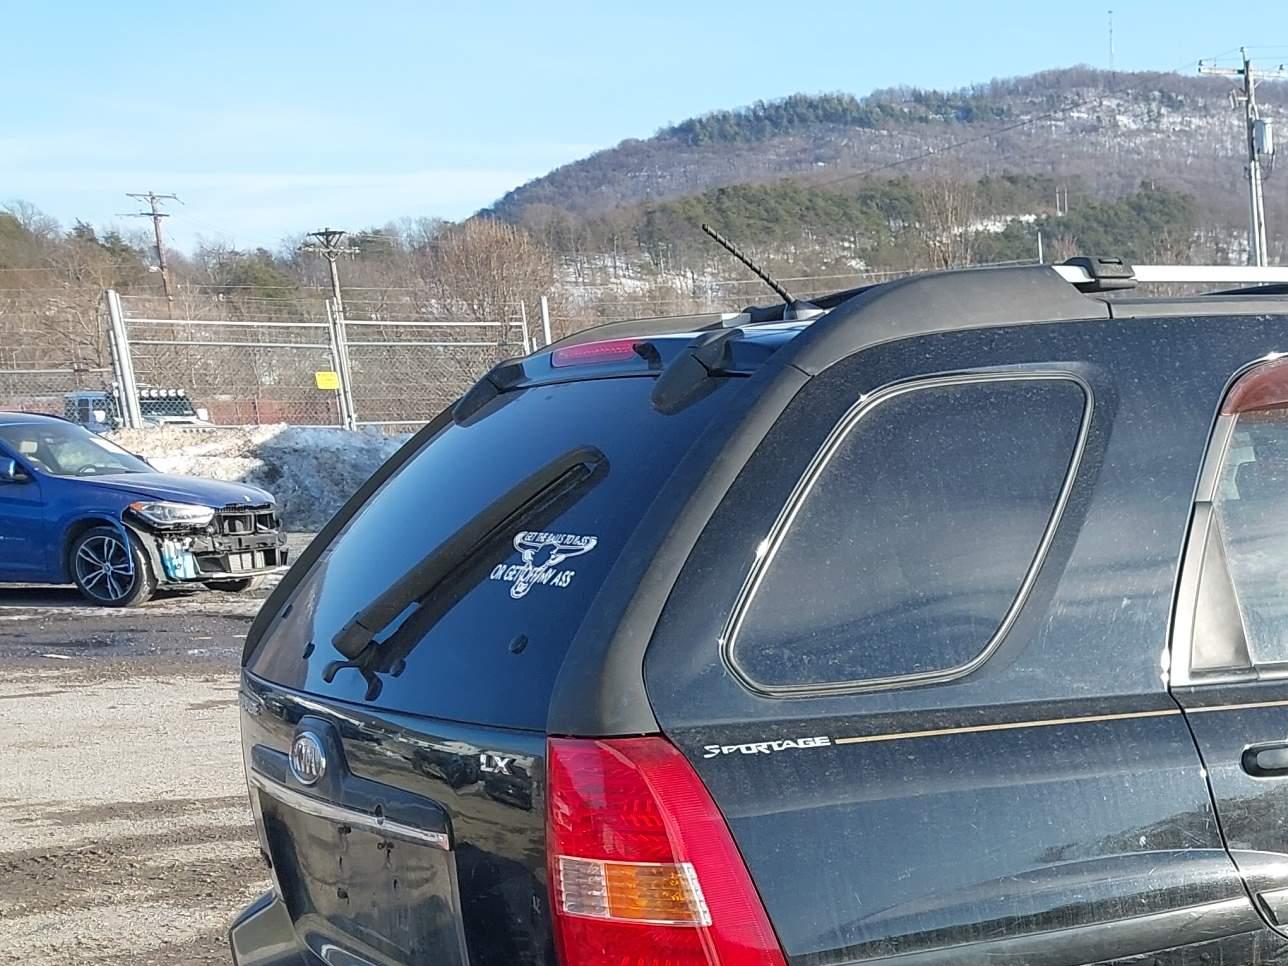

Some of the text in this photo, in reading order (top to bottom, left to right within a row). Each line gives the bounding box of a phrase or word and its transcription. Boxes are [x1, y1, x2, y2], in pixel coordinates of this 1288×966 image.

[490, 564, 506, 580] OR
[503, 564, 522, 582] GET
[549, 570, 576, 587] ASS
[703, 735, 832, 759] SPORTAGE
[480, 753, 513, 776] LX
